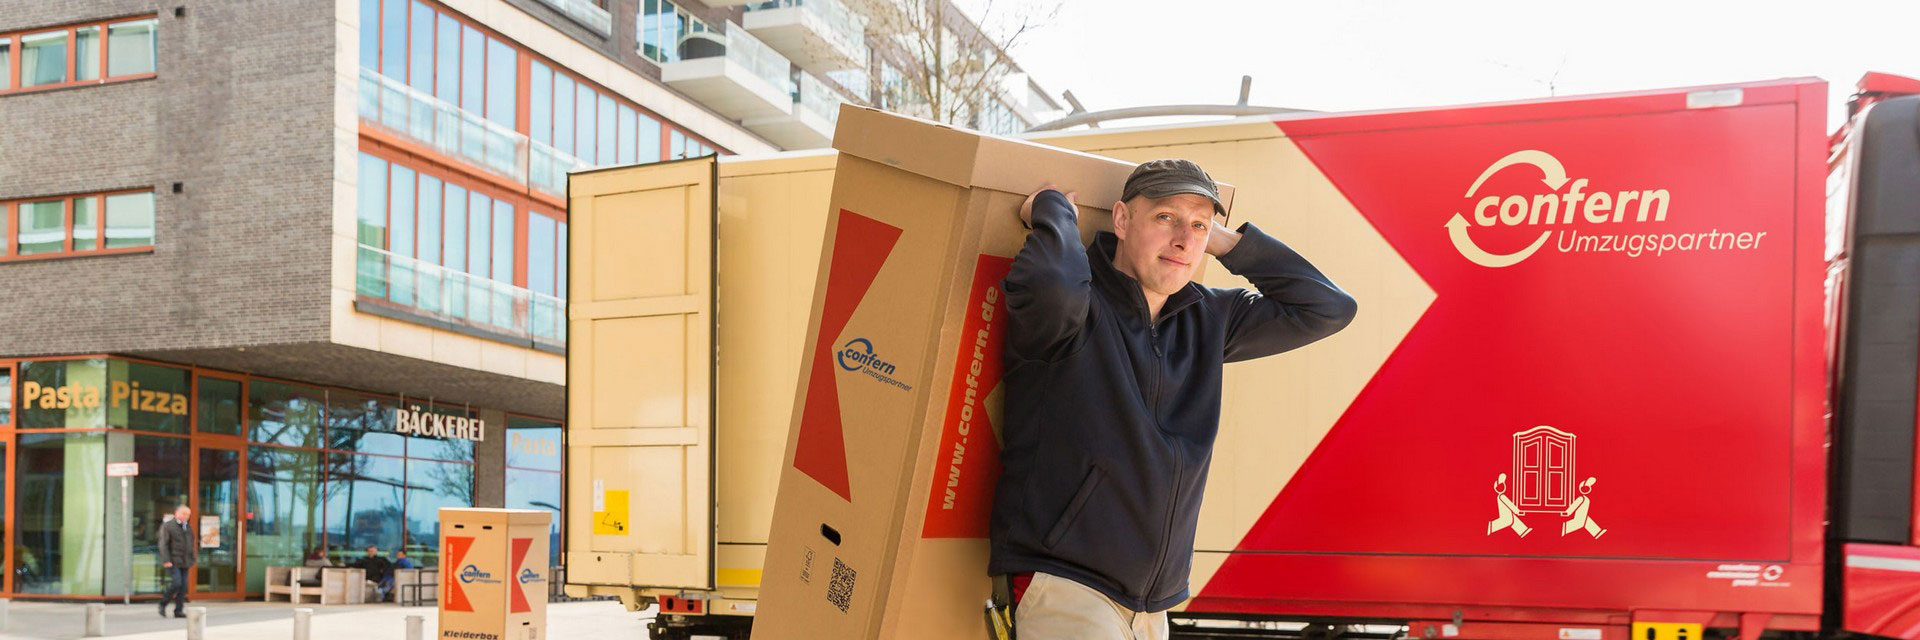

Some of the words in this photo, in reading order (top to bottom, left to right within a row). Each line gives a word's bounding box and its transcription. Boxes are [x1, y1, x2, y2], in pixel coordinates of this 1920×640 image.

[1474, 178, 1671, 227] confern
[1557, 229, 1767, 258] Umzugspartner
[845, 348, 896, 375] confern
[862, 367, 913, 392] Umzugspartner
[23, 381, 99, 409] Pasta
[111, 380, 188, 415] Pizza
[942, 286, 998, 510] www.confern.de
[396, 405, 485, 442] BÄCKEREI
[511, 431, 556, 457] Pasta
[443, 629, 499, 640] Kleiderbox
